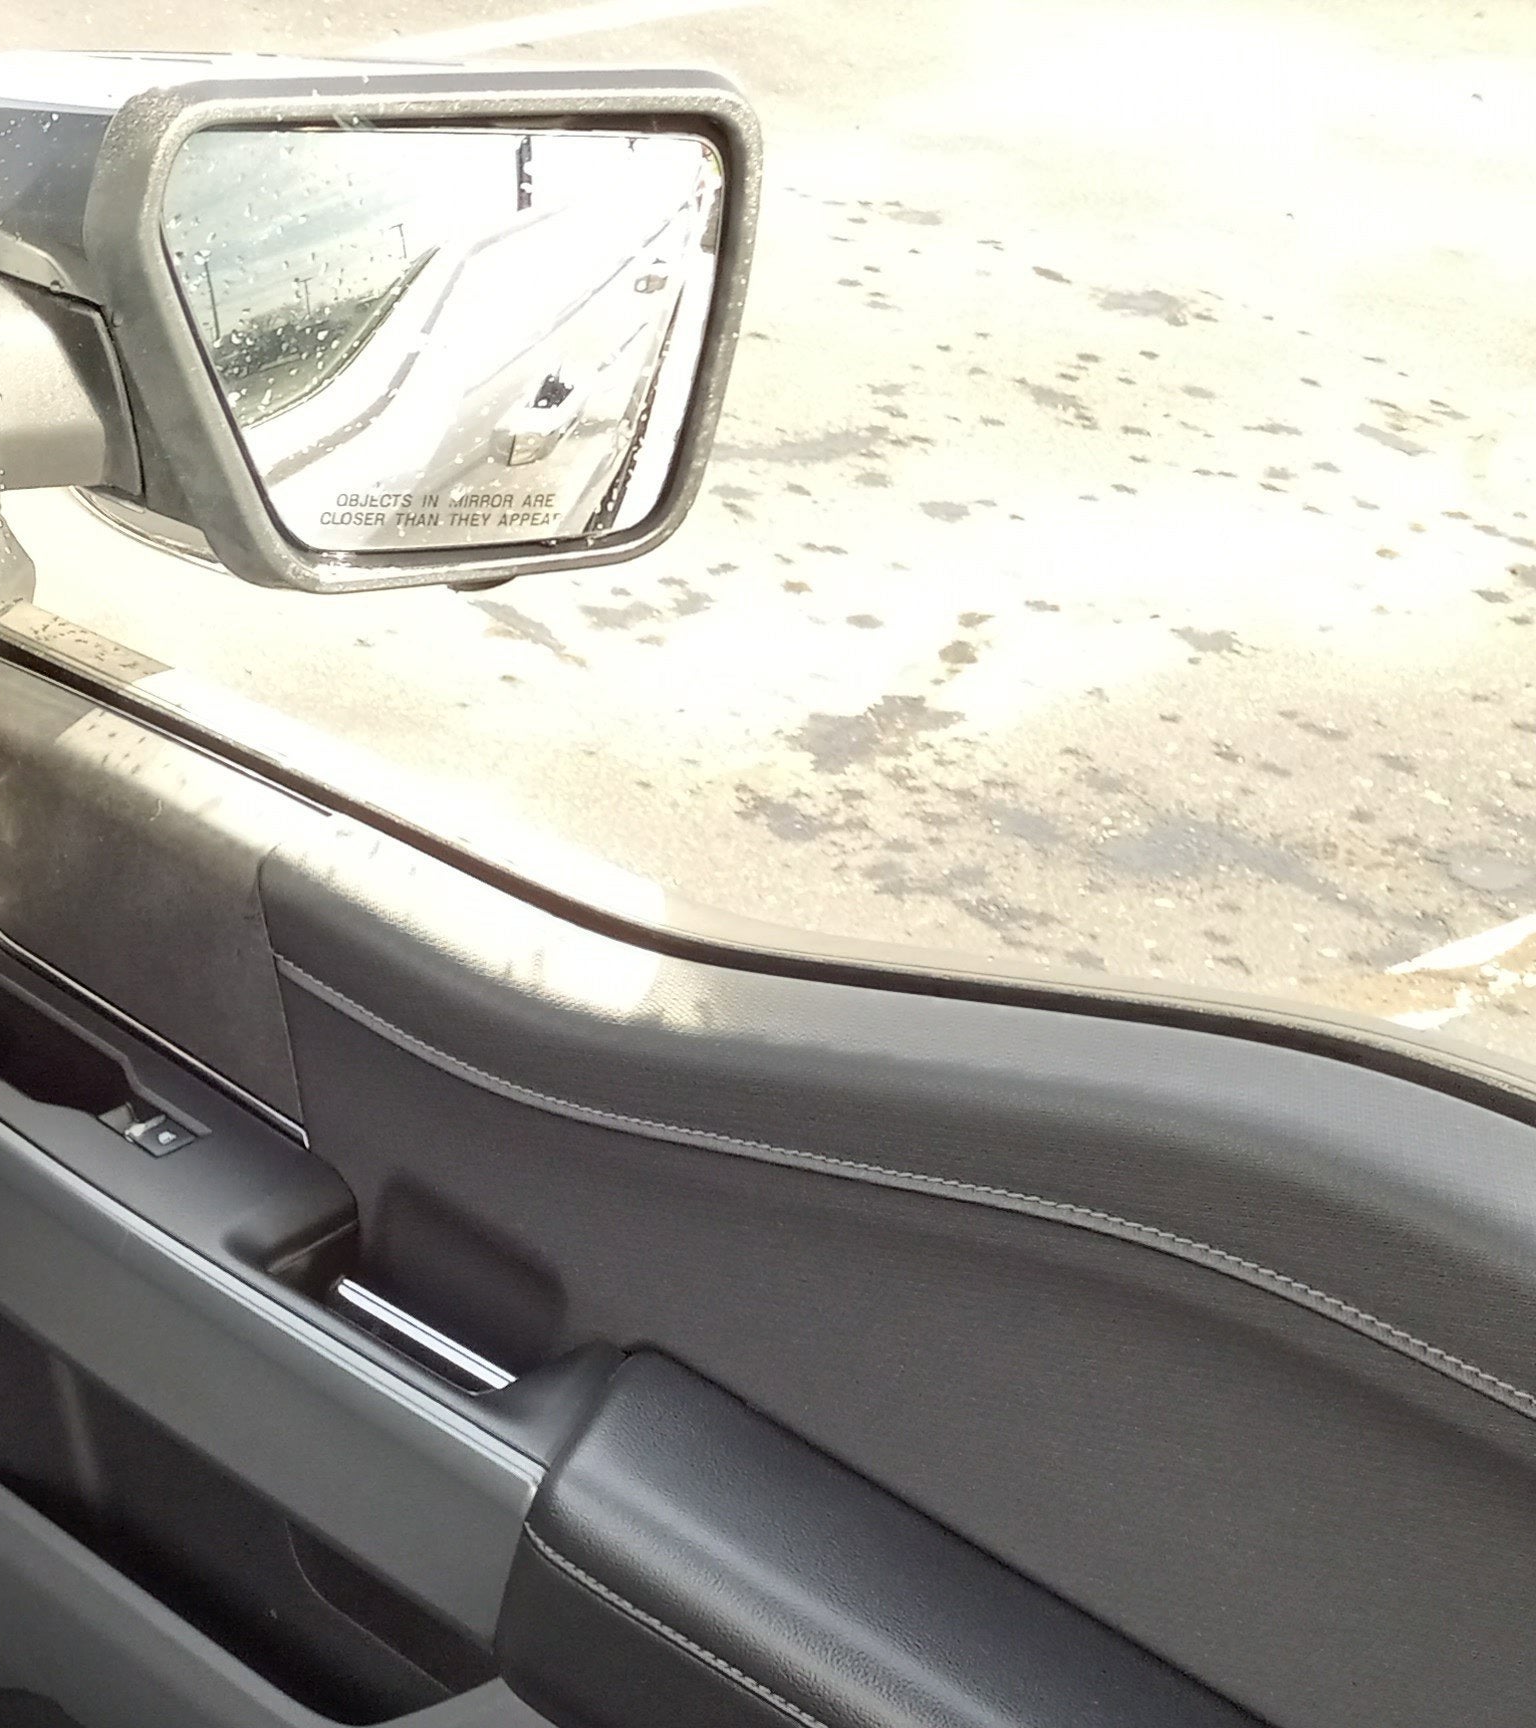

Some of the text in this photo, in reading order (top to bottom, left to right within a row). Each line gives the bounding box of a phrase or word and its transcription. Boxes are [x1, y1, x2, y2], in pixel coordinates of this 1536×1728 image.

[336, 493, 413, 508] OBJECTS
[422, 493, 439, 508] IN
[522, 493, 556, 508] ARE
[320, 511, 385, 526] CLOSER
[396, 511, 440, 526] THAN
[449, 511, 492, 526] THEY
